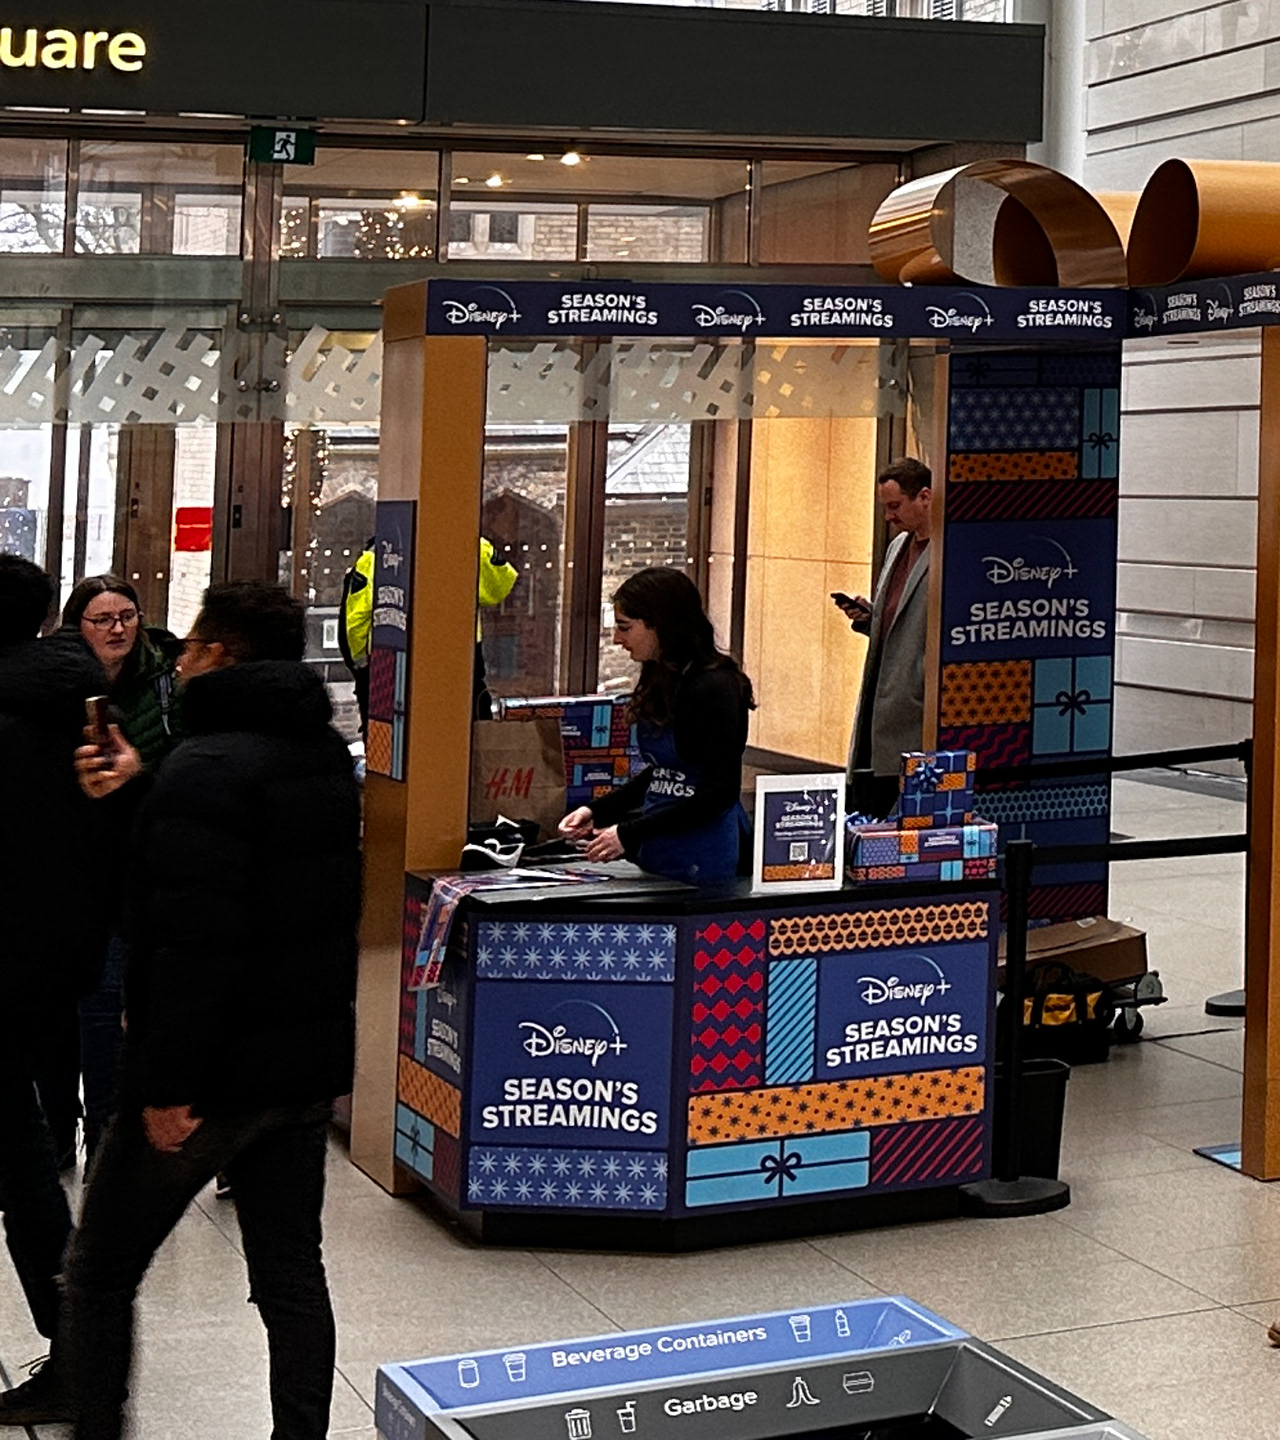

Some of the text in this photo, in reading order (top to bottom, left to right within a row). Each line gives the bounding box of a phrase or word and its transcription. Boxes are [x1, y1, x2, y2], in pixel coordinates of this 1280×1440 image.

[443, 300, 522, 329] Disney+
[561, 294, 647, 309] SEASON'S
[803, 297, 882, 312] SEASON'S
[1028, 299, 1103, 313] SEASON'S
[547, 309, 658, 325] STREAMINGS
[691, 304, 767, 332] Disney+
[790, 312, 894, 328] STREAMINGS
[925, 306, 995, 333] Disney+
[1017, 313, 1113, 328] STREAMINGS
[981, 556, 1078, 590] Disney+
[970, 598, 1090, 622] SEASON'S
[951, 619, 1107, 646] STREAMINGS
[857, 976, 952, 1006] Disney+
[845, 1014, 962, 1042] SEASON'S
[519, 1021, 628, 1067] Disney+
[826, 1034, 978, 1067] STREAMINGS
[504, 1078, 639, 1105] SEASON'S
[482, 1104, 658, 1134] STREAMINGS
[551, 1326, 767, 1368] Beverage Containers
[663, 1390, 758, 1418] Garbage
